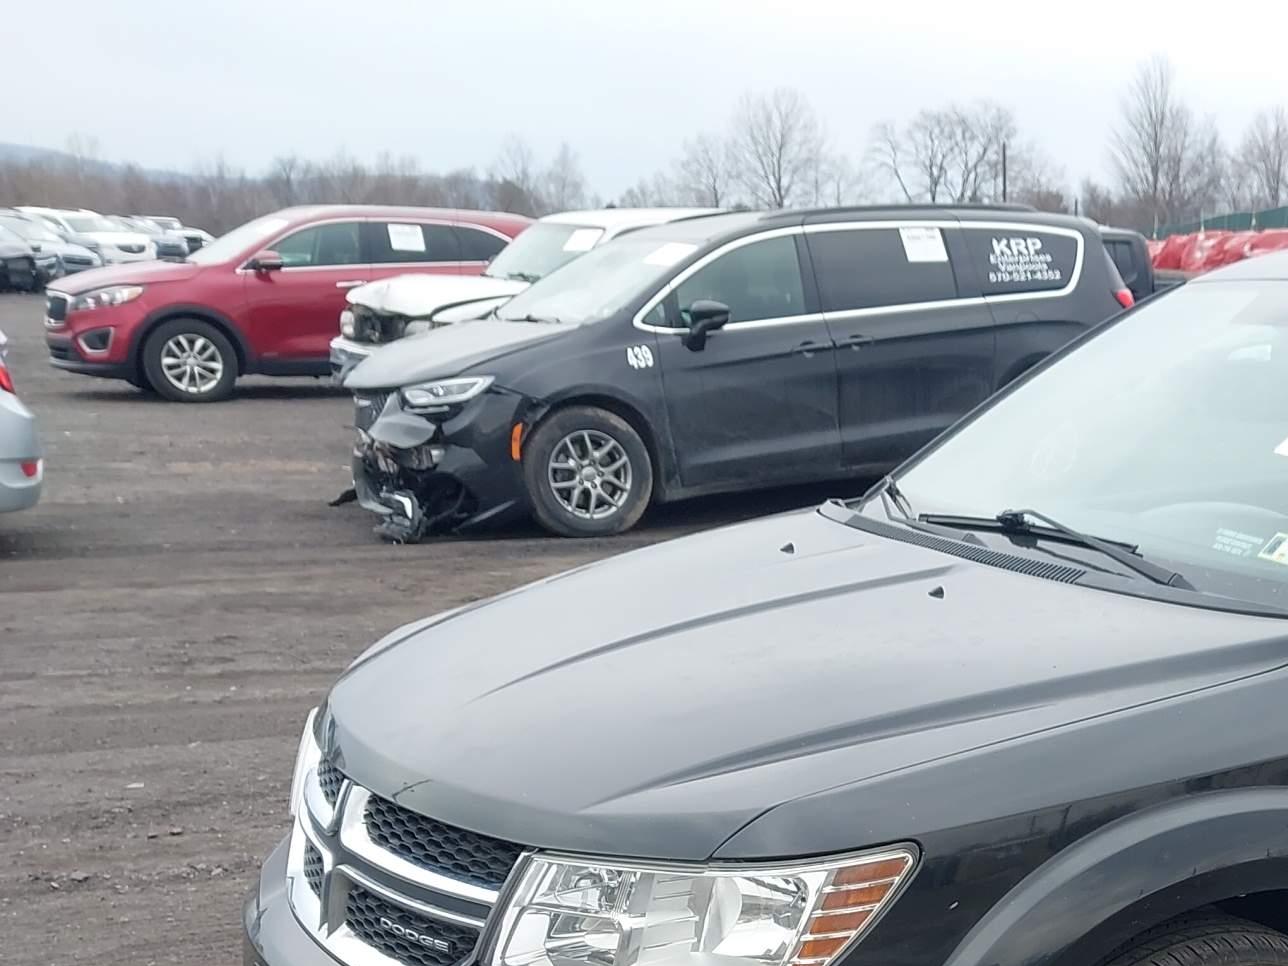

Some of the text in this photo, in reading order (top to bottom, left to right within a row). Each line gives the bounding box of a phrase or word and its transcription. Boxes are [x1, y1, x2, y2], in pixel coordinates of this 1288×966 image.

[991, 237, 1042, 256] KRP
[627, 344, 654, 370] 439
[380, 917, 450, 952] DODGE
